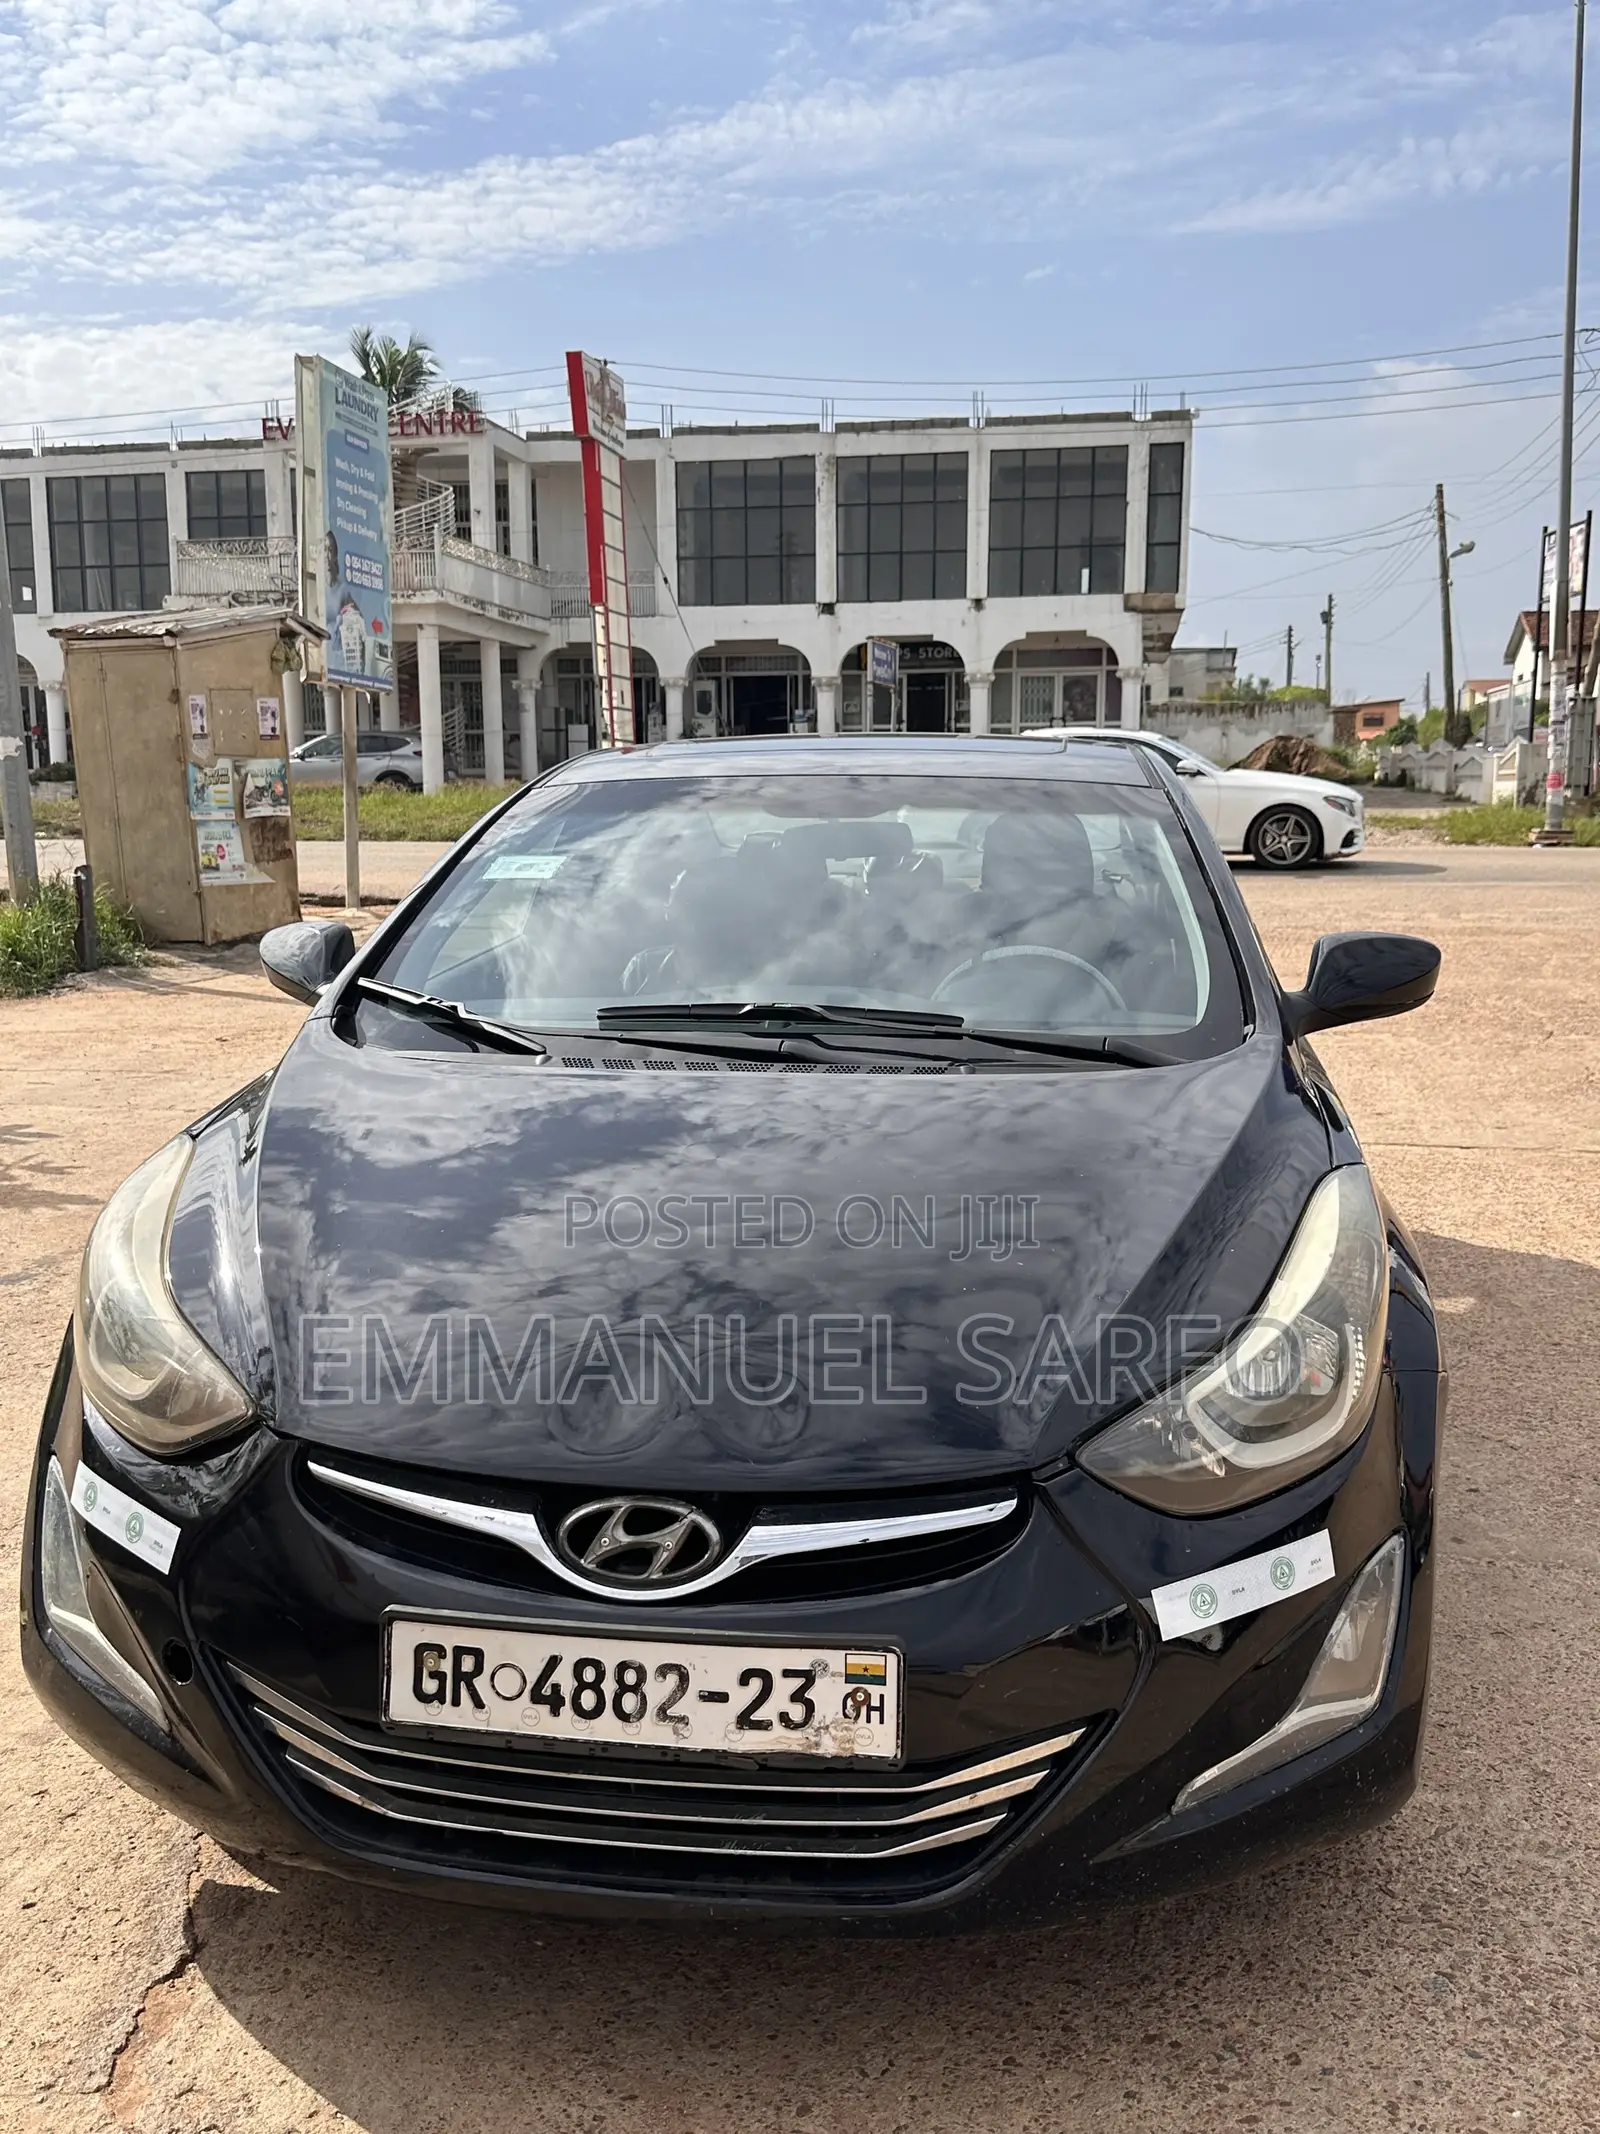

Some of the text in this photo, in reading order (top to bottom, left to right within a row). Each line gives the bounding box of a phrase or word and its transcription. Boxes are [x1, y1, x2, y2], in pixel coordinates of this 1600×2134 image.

[335, 386, 379, 423] LAUNDRY
[351, 463, 359, 479] Dry
[364, 468, 375, 482] Fold
[336, 496, 367, 520] Dry Cleaning
[336, 516, 353, 535] Pickup
[358, 524, 378, 542] Delivery
[412, 1641, 817, 1731] GR 4882-23
